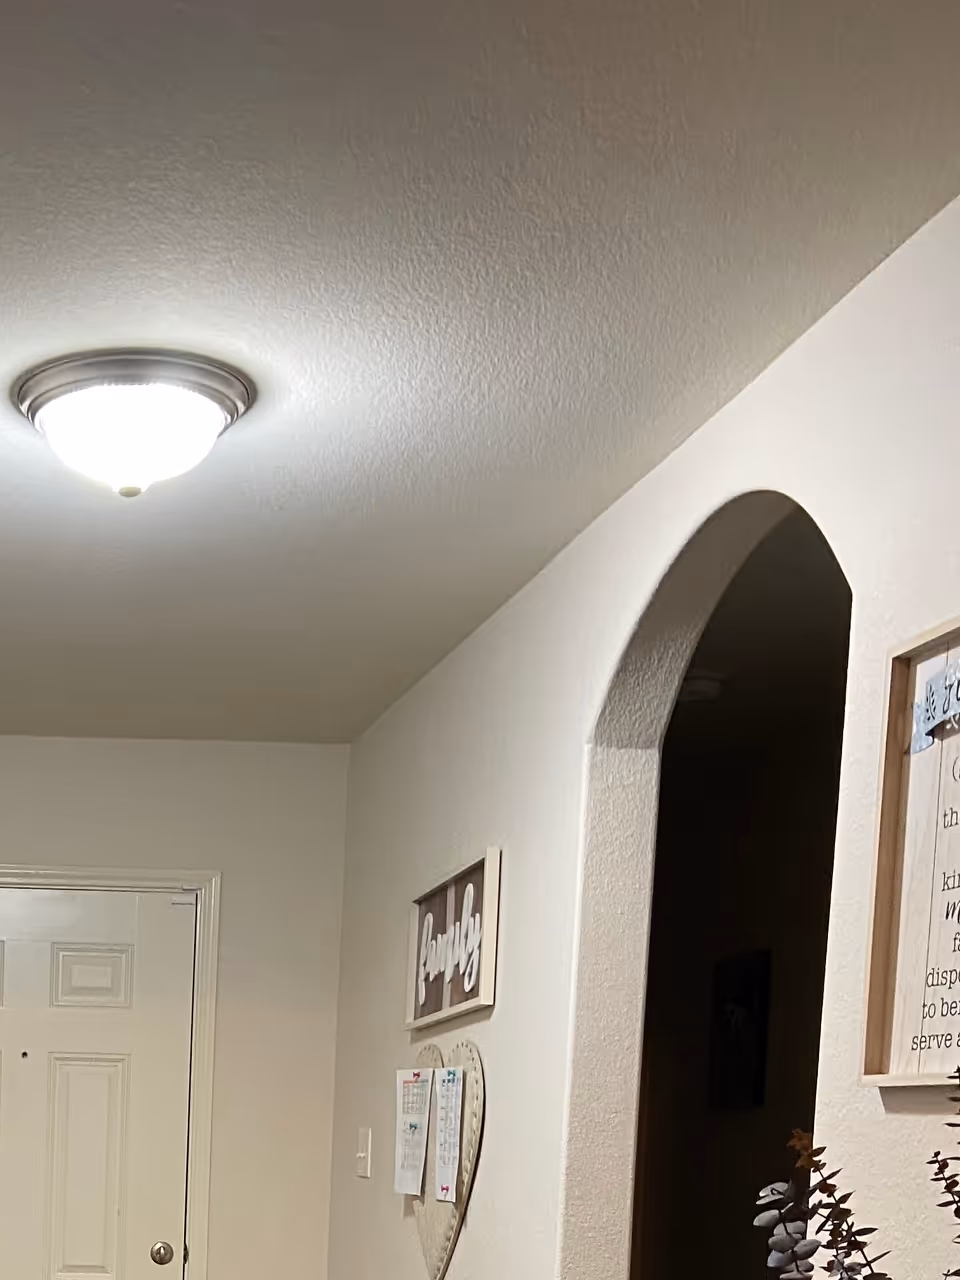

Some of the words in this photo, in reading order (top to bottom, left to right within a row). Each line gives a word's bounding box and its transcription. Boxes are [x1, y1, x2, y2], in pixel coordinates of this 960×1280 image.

[417, 882, 482, 1007] family
[922, 1002, 937, 1020] to
[911, 1031, 953, 1052] serve
